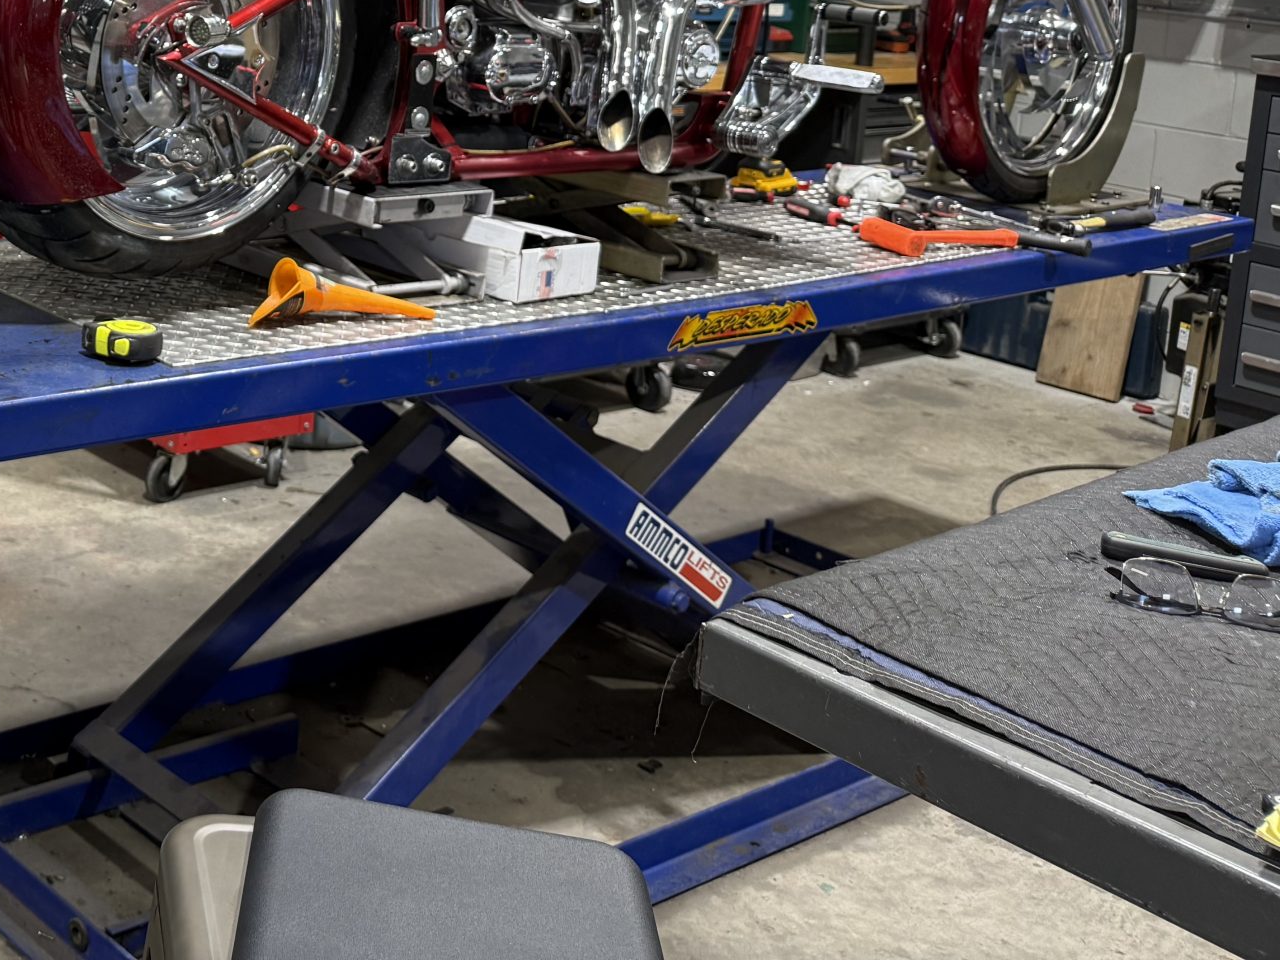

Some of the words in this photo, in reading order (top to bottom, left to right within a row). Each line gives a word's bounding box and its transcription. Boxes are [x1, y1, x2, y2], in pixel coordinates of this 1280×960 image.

[691, 306, 794, 337] DESPERADO
[629, 509, 690, 571] AMMCO
[686, 550, 730, 590] LIFTS
